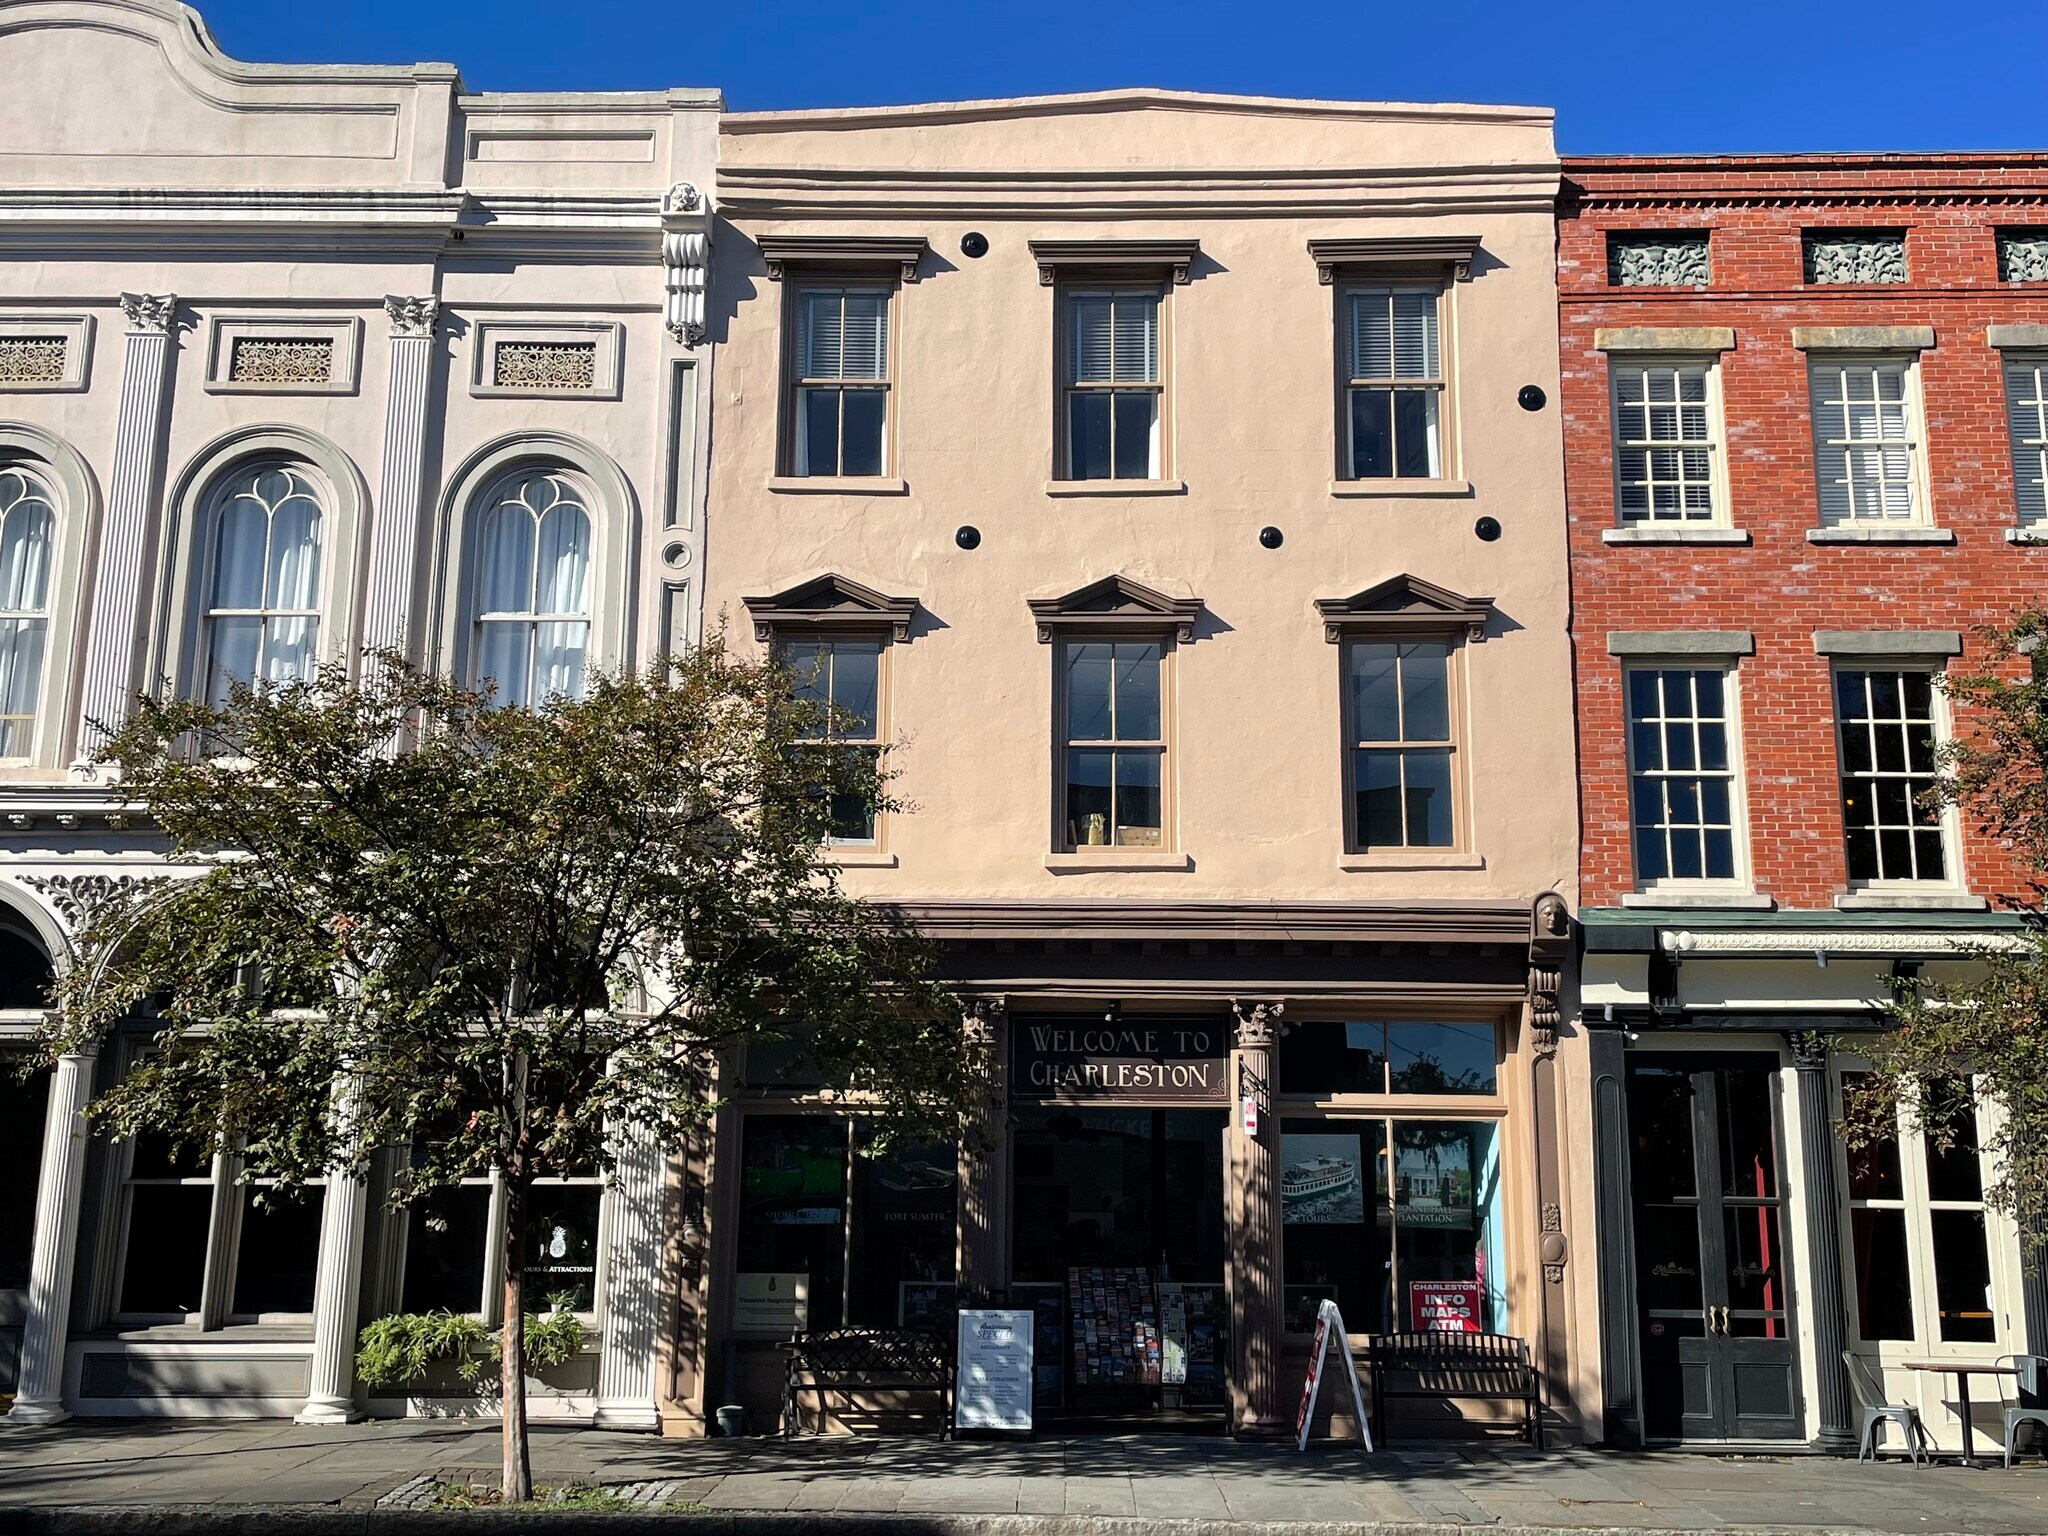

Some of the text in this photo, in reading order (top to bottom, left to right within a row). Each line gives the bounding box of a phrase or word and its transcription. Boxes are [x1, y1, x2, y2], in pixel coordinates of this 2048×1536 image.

[1029, 1023, 1210, 1053] WELCOME TO
[1029, 1060, 1210, 1089] CHARLESTON
[1396, 1204, 1453, 1214] BOONE HALL
[885, 1212, 946, 1221] FORT SUMTER
[1300, 1213, 1332, 1222] TOURS
[1396, 1214, 1453, 1223] PLANTATION
[1413, 1283, 1477, 1291] CHARLESTON
[1424, 1294, 1466, 1305] INFO
[1420, 1307, 1471, 1318] MAPS
[1428, 1319, 1463, 1331] ATM
